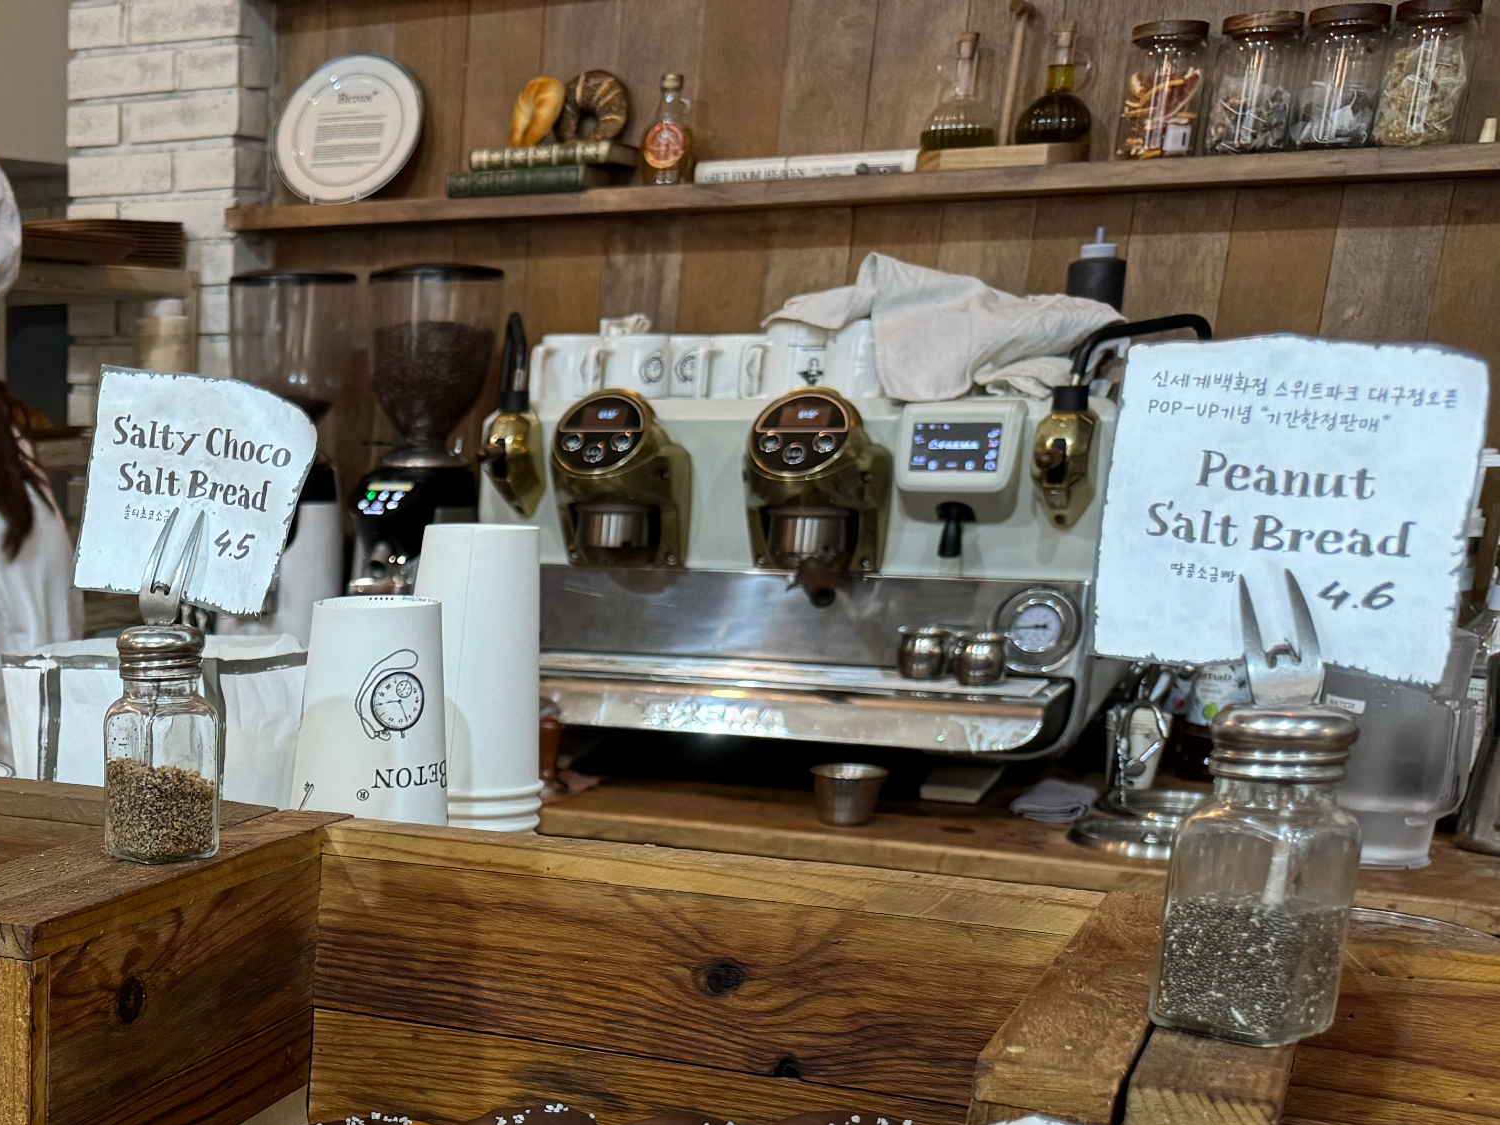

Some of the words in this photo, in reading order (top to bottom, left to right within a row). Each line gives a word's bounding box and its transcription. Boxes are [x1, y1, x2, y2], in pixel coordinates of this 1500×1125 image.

[1152, 370, 1267, 396] 신세계백화점
[1274, 380, 1359, 402] 스위트파크
[1148, 400, 1253, 425] POP-UP기념
[112, 414, 201, 456] Salty
[205, 427, 292, 467] Choco
[117, 461, 182, 497] Salt
[186, 470, 272, 512] Bread
[1195, 449, 1376, 500] Peanut
[213, 529, 256, 560] 4.5
[1146, 500, 1238, 547] Salt
[1249, 514, 1417, 558] Bread
[1170, 562, 1236, 583] 땅콩소금빵
[1317, 581, 1395, 611] 4.6
